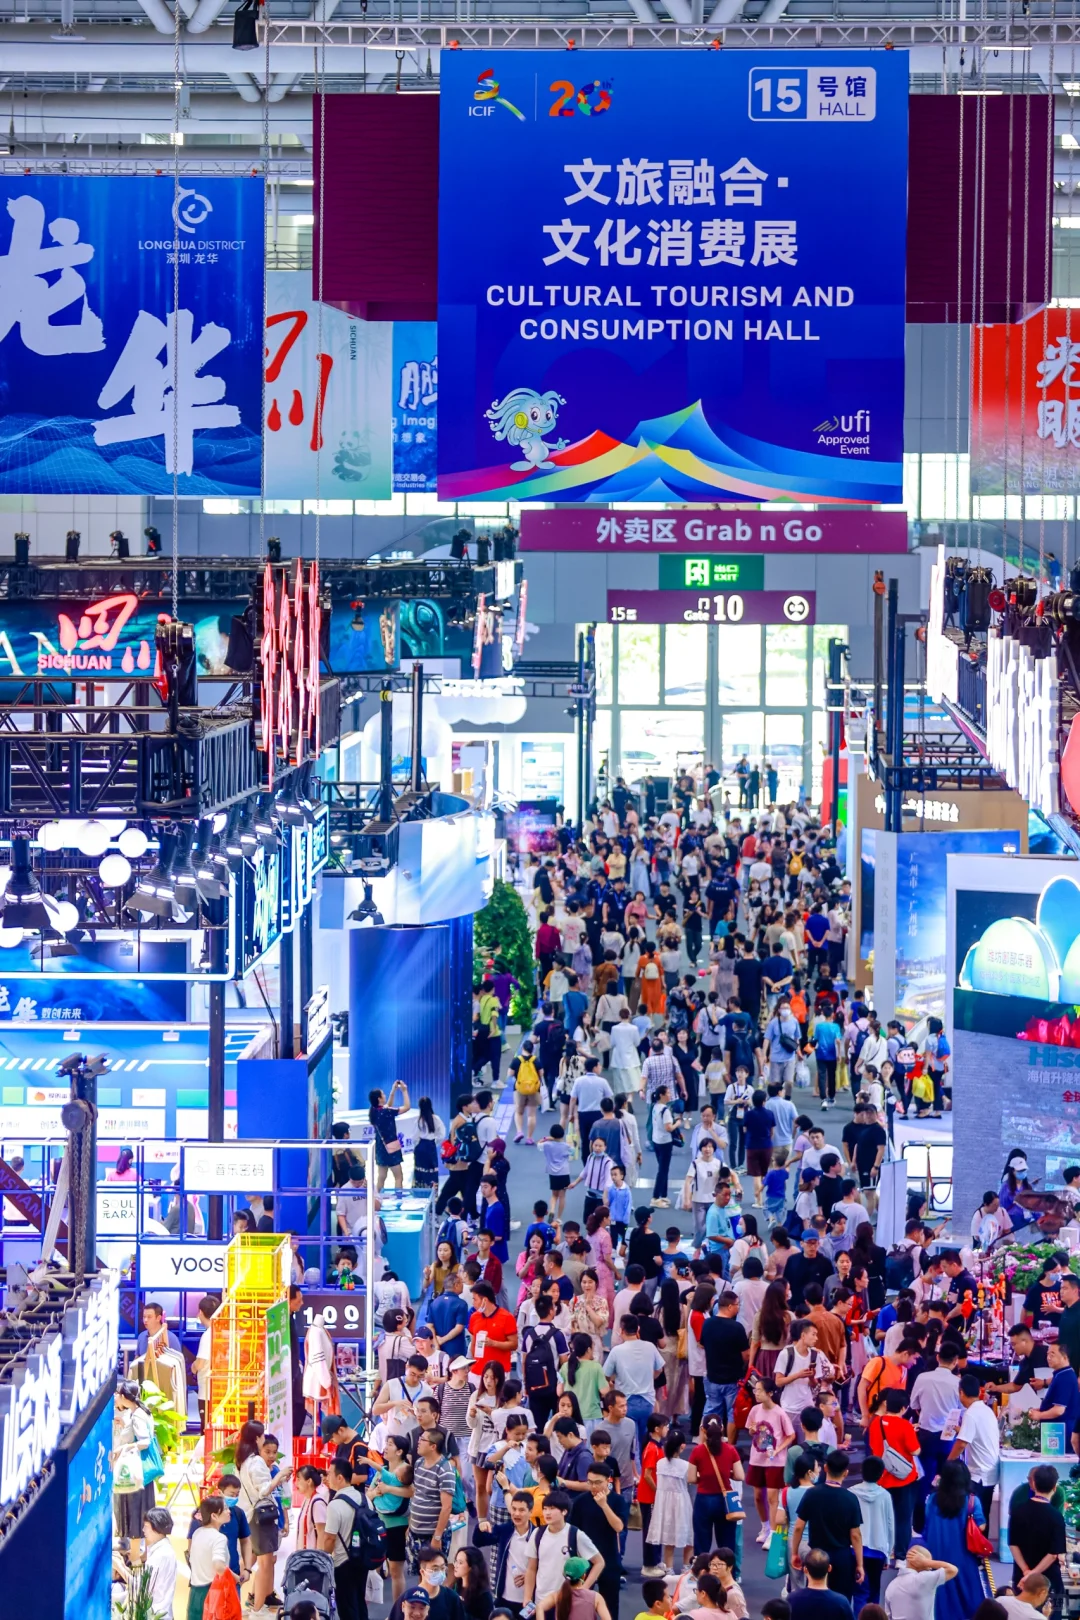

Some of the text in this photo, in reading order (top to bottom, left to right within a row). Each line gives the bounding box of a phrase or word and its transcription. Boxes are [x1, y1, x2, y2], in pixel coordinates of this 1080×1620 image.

[754, 78, 802, 112] 15
[817, 76, 867, 97] 号馆
[468, 106, 496, 117] ICIF
[819, 102, 866, 116] HALL
[138, 240, 246, 250] LONGHUA DISTRICT
[542, 219, 799, 267] 文化消费展
[486, 285, 855, 307] CULTURAL TOURISM AND
[519, 319, 820, 341] CONSUMPTION HALL
[349, 325, 357, 361] SICHUAN
[402, 414, 437, 430] Imag
[841, 409, 871, 433] ufi
[817, 434, 870, 446] Approved
[840, 445, 871, 455] Event
[597, 517, 823, 544] 外卖区 Grab n Go
[714, 573, 739, 582] EXIT
[713, 594, 744, 622] 10
[37, 654, 112, 670] SICHUAN
